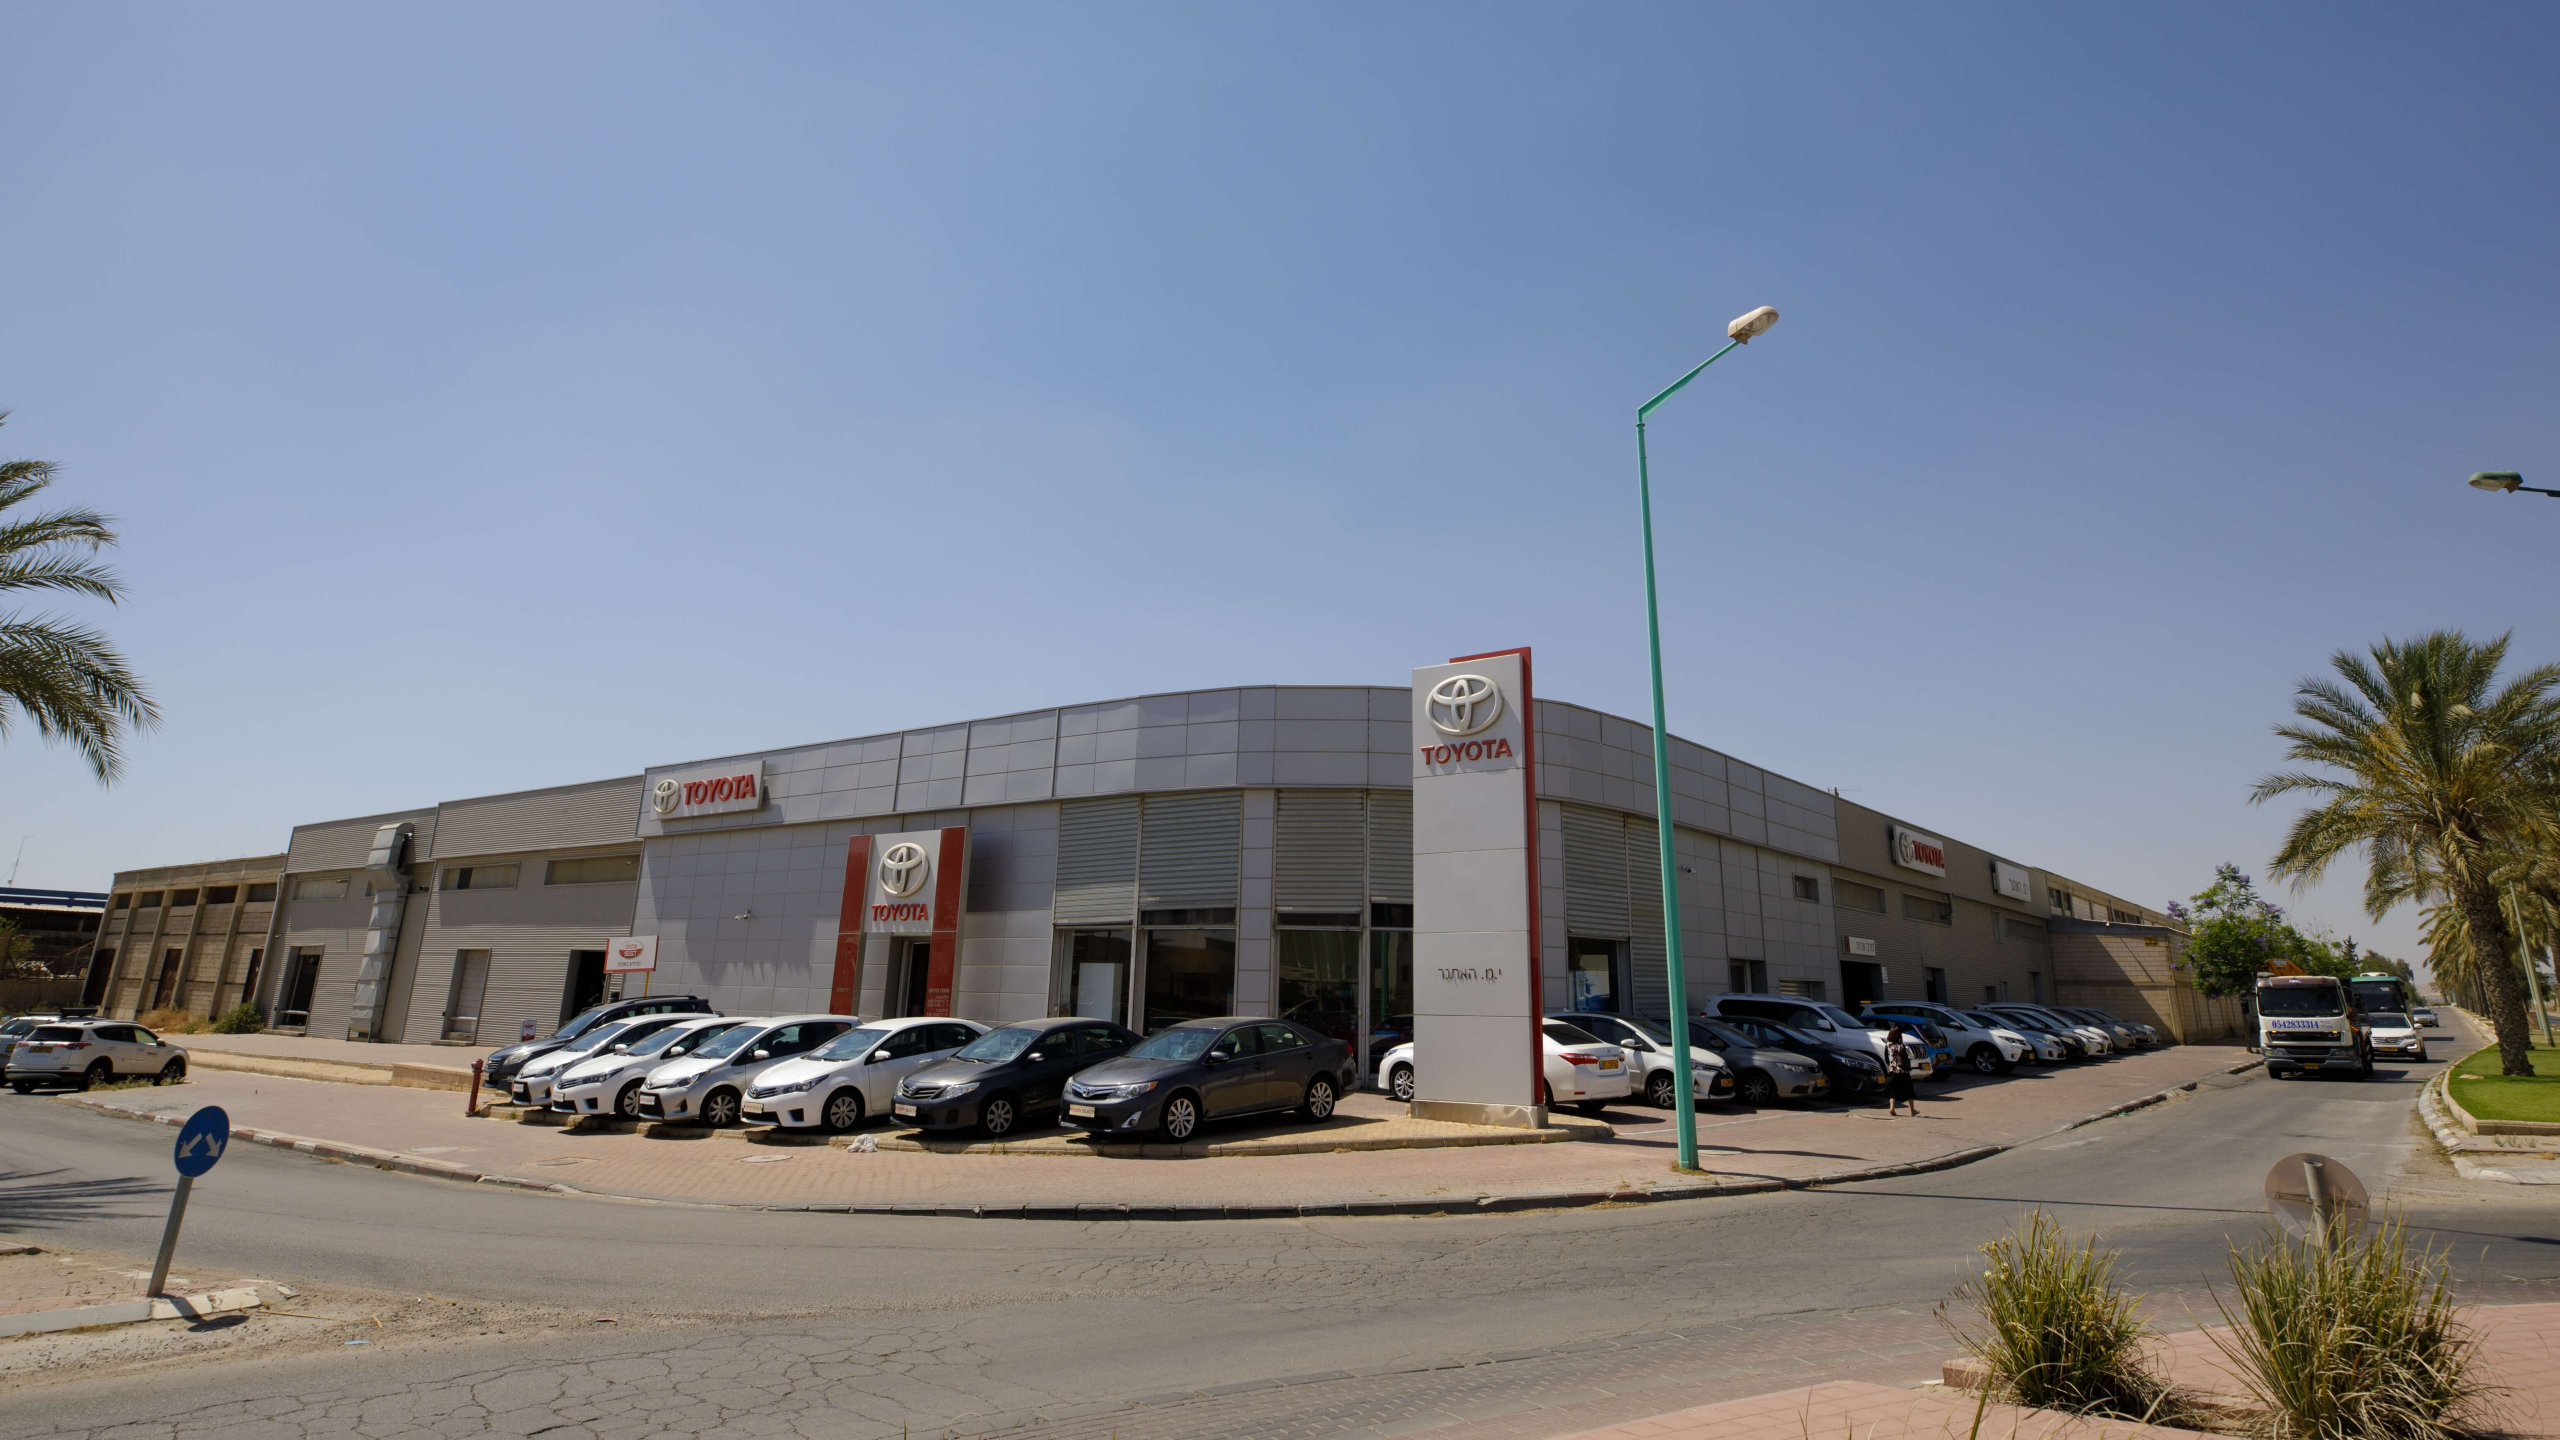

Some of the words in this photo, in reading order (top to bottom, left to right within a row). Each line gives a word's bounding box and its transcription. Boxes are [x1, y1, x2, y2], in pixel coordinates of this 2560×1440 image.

[1421, 738, 1512, 765] TOYOTA
[683, 773, 756, 805] TOYOTA
[1913, 840, 1945, 869] TOYOTA
[871, 903, 929, 921] TOYOTA
[2271, 1020, 2319, 1029] 0542833314
